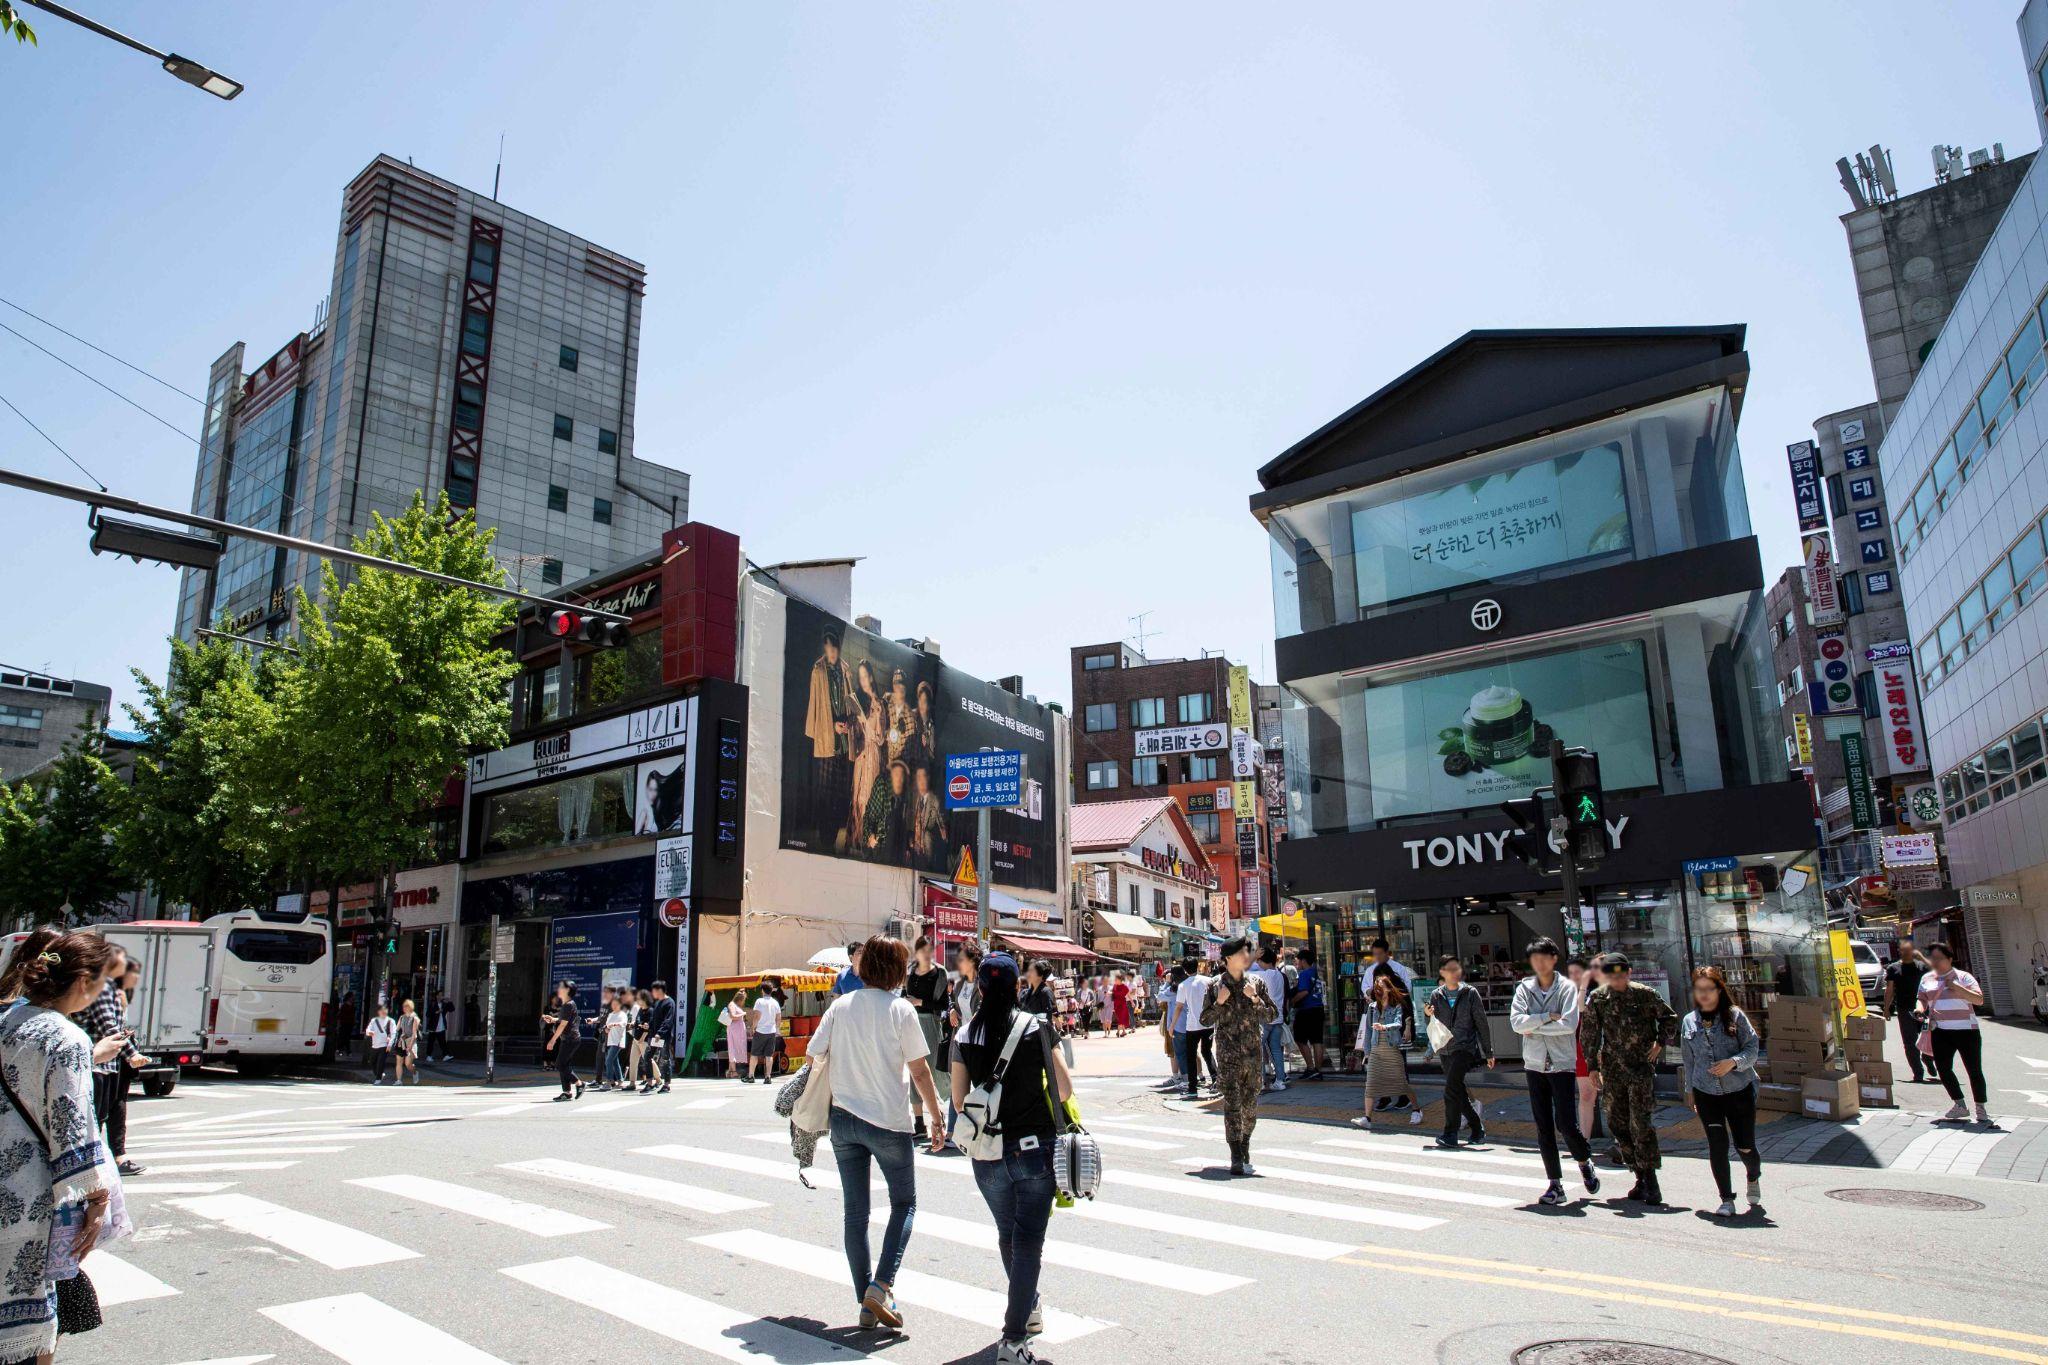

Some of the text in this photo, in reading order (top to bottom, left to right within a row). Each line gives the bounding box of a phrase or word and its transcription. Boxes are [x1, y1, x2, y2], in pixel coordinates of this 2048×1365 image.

[1794, 459, 1814, 471] 홍대
[1796, 472, 1819, 518] 고시텔
[1419, 526, 1438, 535] 햇살과
[1439, 518, 1459, 531] 바람이
[1475, 510, 1489, 520] 자연
[1505, 501, 1526, 513] 녹차의
[1528, 496, 1550, 508] 힘으로
[1847, 449, 1888, 592] 홍대고시텔
[1412, 511, 1562, 564] 더 순하고 더 촉촉하게
[622, 581, 657, 614] Hut
[961, 697, 968, 711] 온
[968, 699, 984, 717] 몸으로
[985, 707, 1005, 726] 추리하는
[1883, 671, 1917, 766] 노래연습장
[636, 737, 675, 754] T.332.5211
[1147, 733, 1202, 753] 수제담배
[1799, 729, 1809, 754] 부동산
[949, 754, 1018, 769] 어울마당로 보행전용거리
[970, 768, 1018, 778] (차량통행제한)
[1847, 738, 1868, 823] GREEN BEAN COFFEE
[970, 794, 1017, 804] 14:00~22:00
[1012, 843, 1032, 859] NETFLIX
[1403, 816, 1629, 869] TONYY
[1885, 838, 1930, 848] 노래연습장
[661, 850, 687, 867] ELLINE
[1687, 861, 1710, 872] Blue
[1974, 891, 2018, 900] Bershka
[1821, 967, 1852, 977] GRAND
[1823, 976, 1855, 987] OPEN
